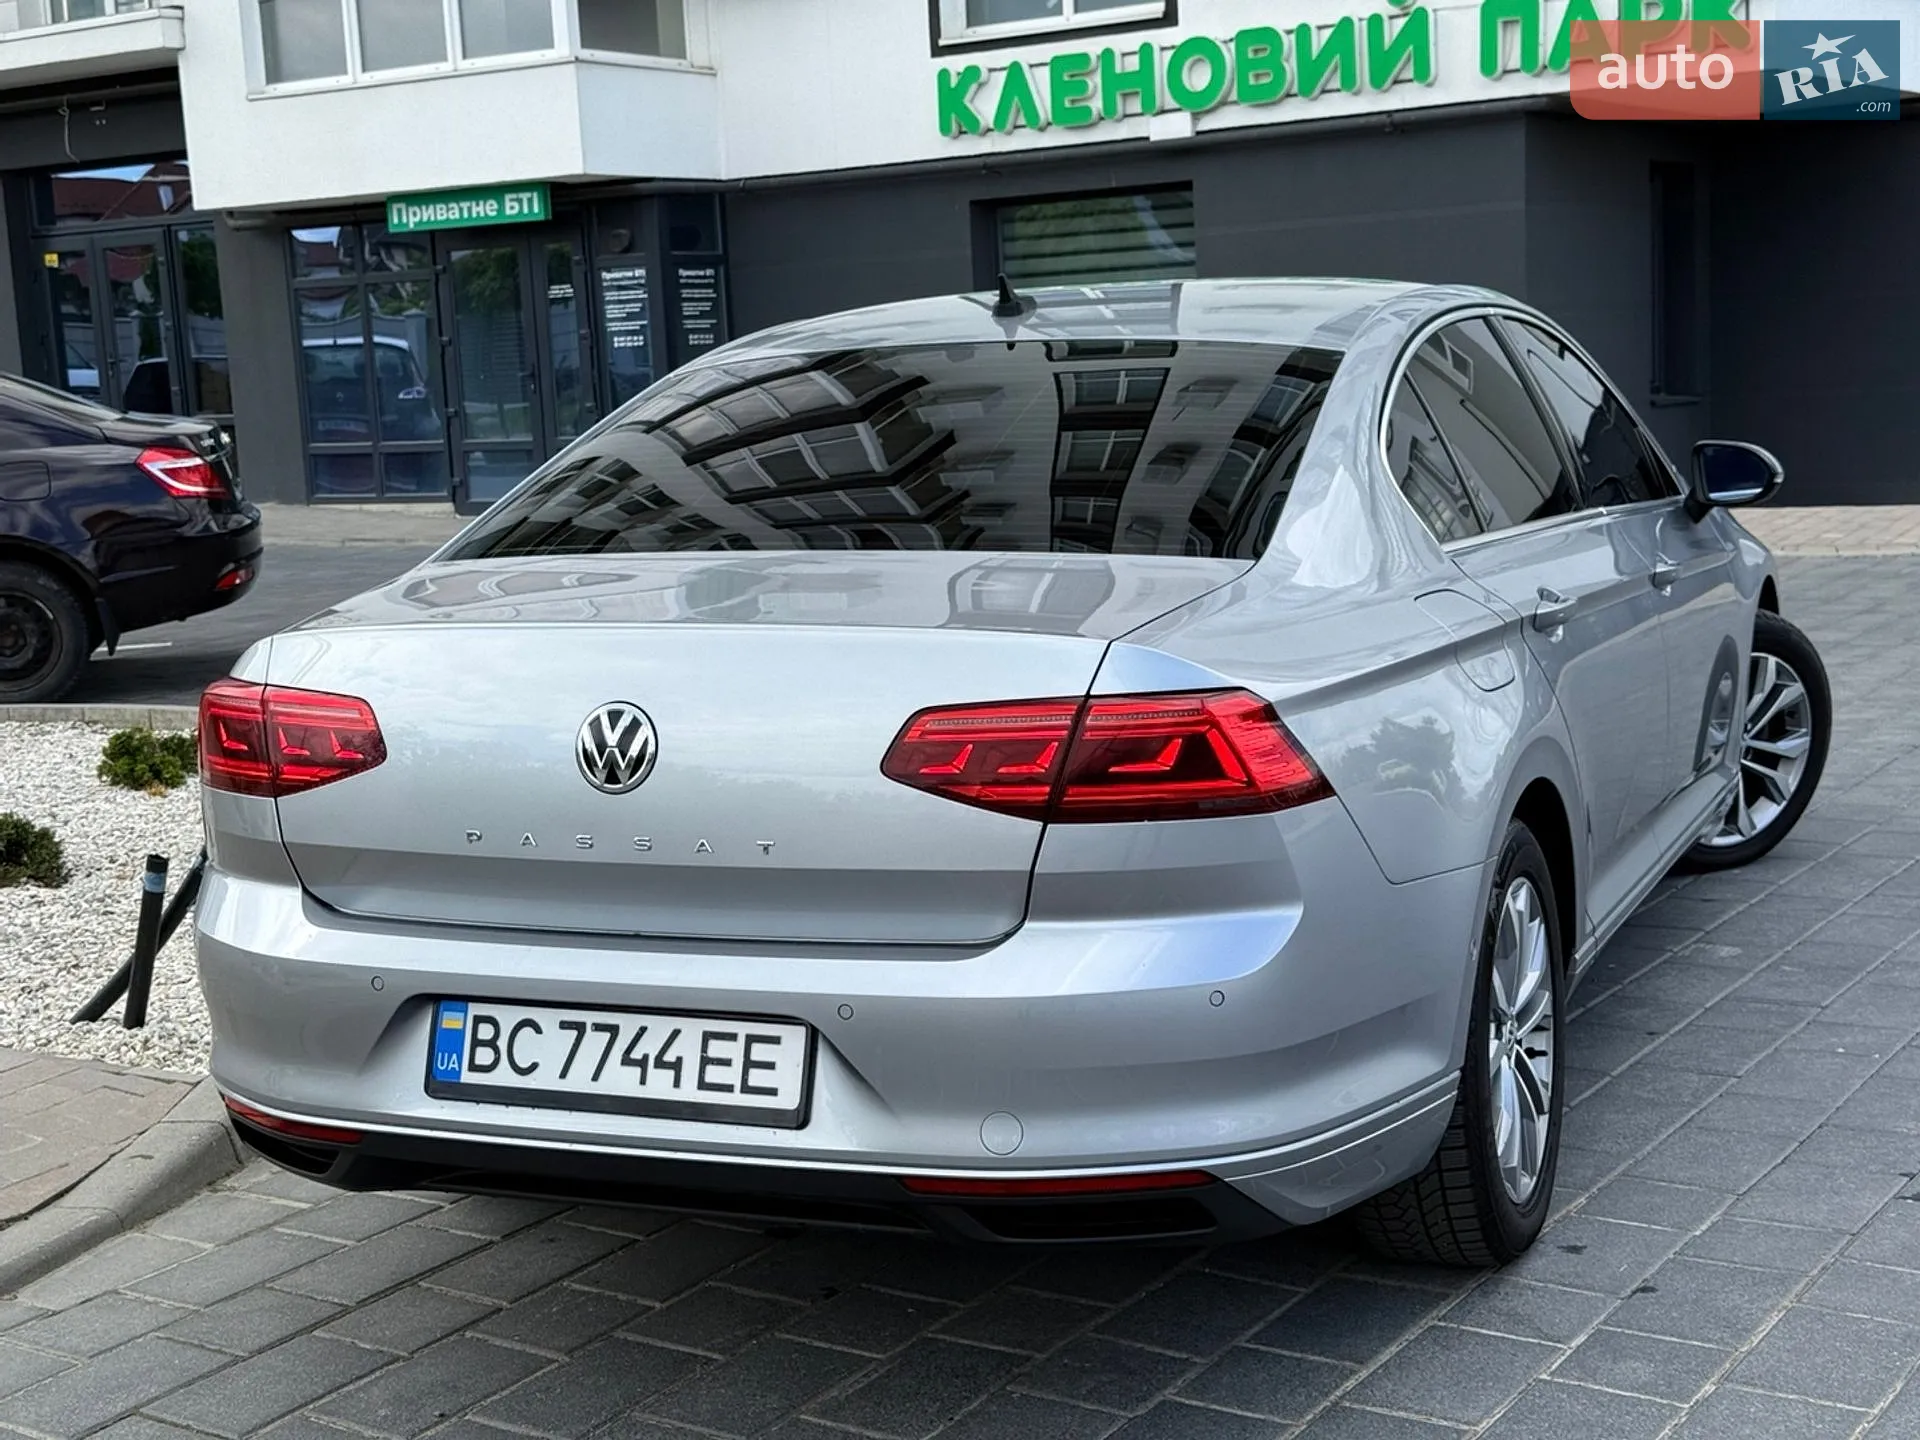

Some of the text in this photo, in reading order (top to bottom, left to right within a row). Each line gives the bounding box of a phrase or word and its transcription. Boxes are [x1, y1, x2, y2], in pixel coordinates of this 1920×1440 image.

[936, 0, 1753, 137] КЛЕНОВИЙ ПАРК
[391, 191, 539, 229] Приватне БТІ
[465, 829, 776, 856] PASSAT
[436, 1051, 460, 1072] UA
[467, 1014, 782, 1097] BC 7744 EE
